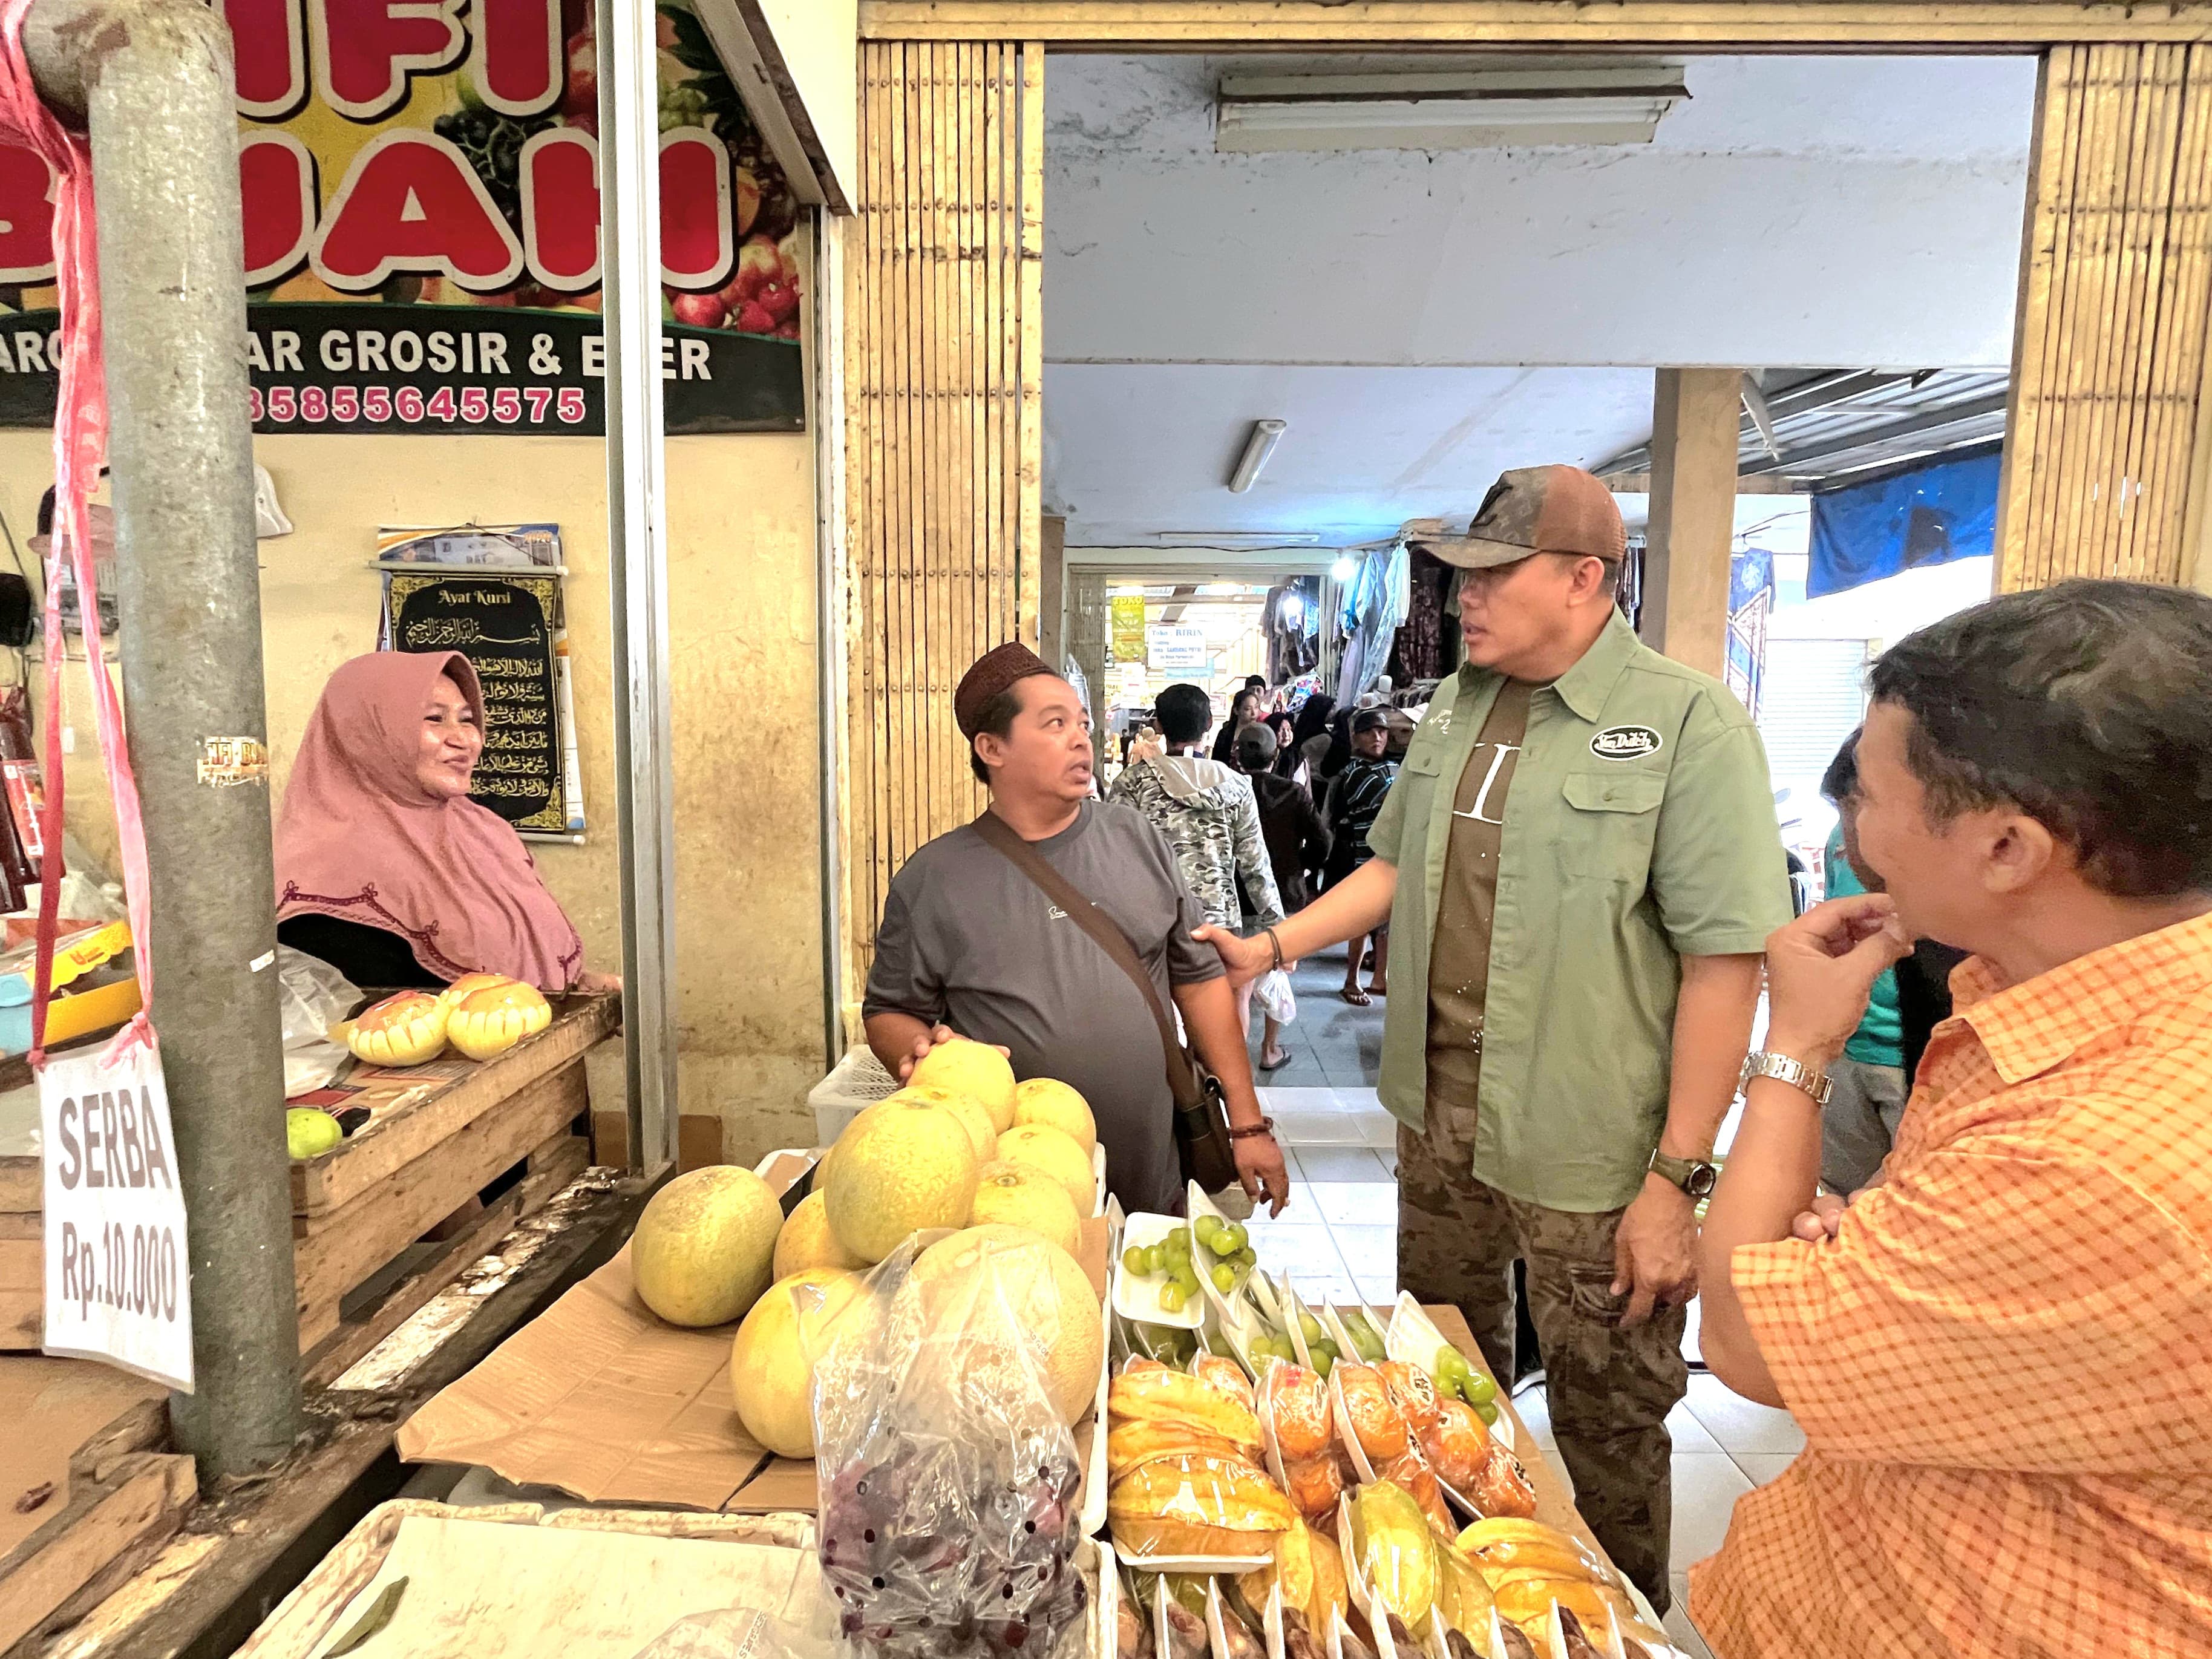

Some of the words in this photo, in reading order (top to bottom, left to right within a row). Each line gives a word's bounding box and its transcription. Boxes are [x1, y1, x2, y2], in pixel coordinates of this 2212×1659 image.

[319, 330, 511, 373] GROSIR
[529, 333, 562, 375] &
[581, 335, 713, 380] EER
[438, 590, 471, 606] Ayat
[474, 589, 511, 605] Kursi
[59, 1085, 172, 1190] SERBA
[63, 1221, 177, 1321] Rp.10.000
